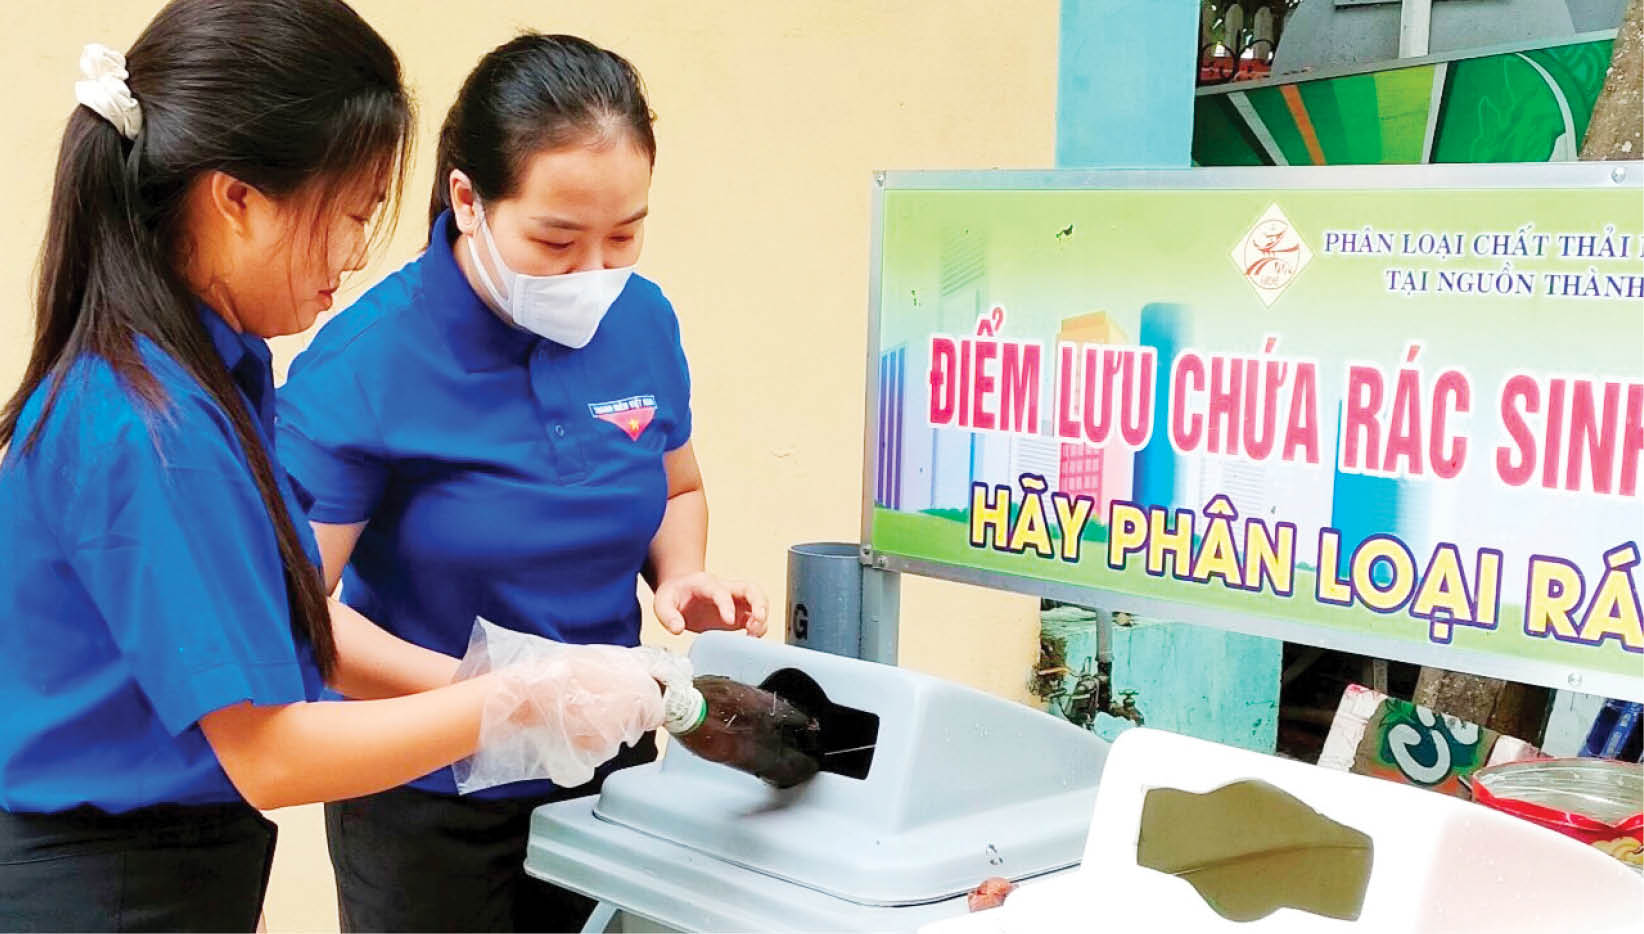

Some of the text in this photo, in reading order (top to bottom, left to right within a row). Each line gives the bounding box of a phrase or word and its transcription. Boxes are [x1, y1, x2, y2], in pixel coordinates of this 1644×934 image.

[1324, 227, 1394, 254] PHÂN
[1401, 233, 1463, 260] LOẠI
[1473, 224, 1549, 257] CHẤT
[1558, 226, 1631, 258] THẢI
[1386, 262, 1644, 298] TẠI NGUỒN THÀNH
[929, 306, 1042, 435] ĐIỂM
[1172, 337, 1319, 464] CHỨA
[1343, 345, 1471, 480] RÁC
[969, 473, 1095, 564] HÃY
[1107, 494, 1298, 598] PHÂN
[1315, 526, 1504, 645] LOẠI
